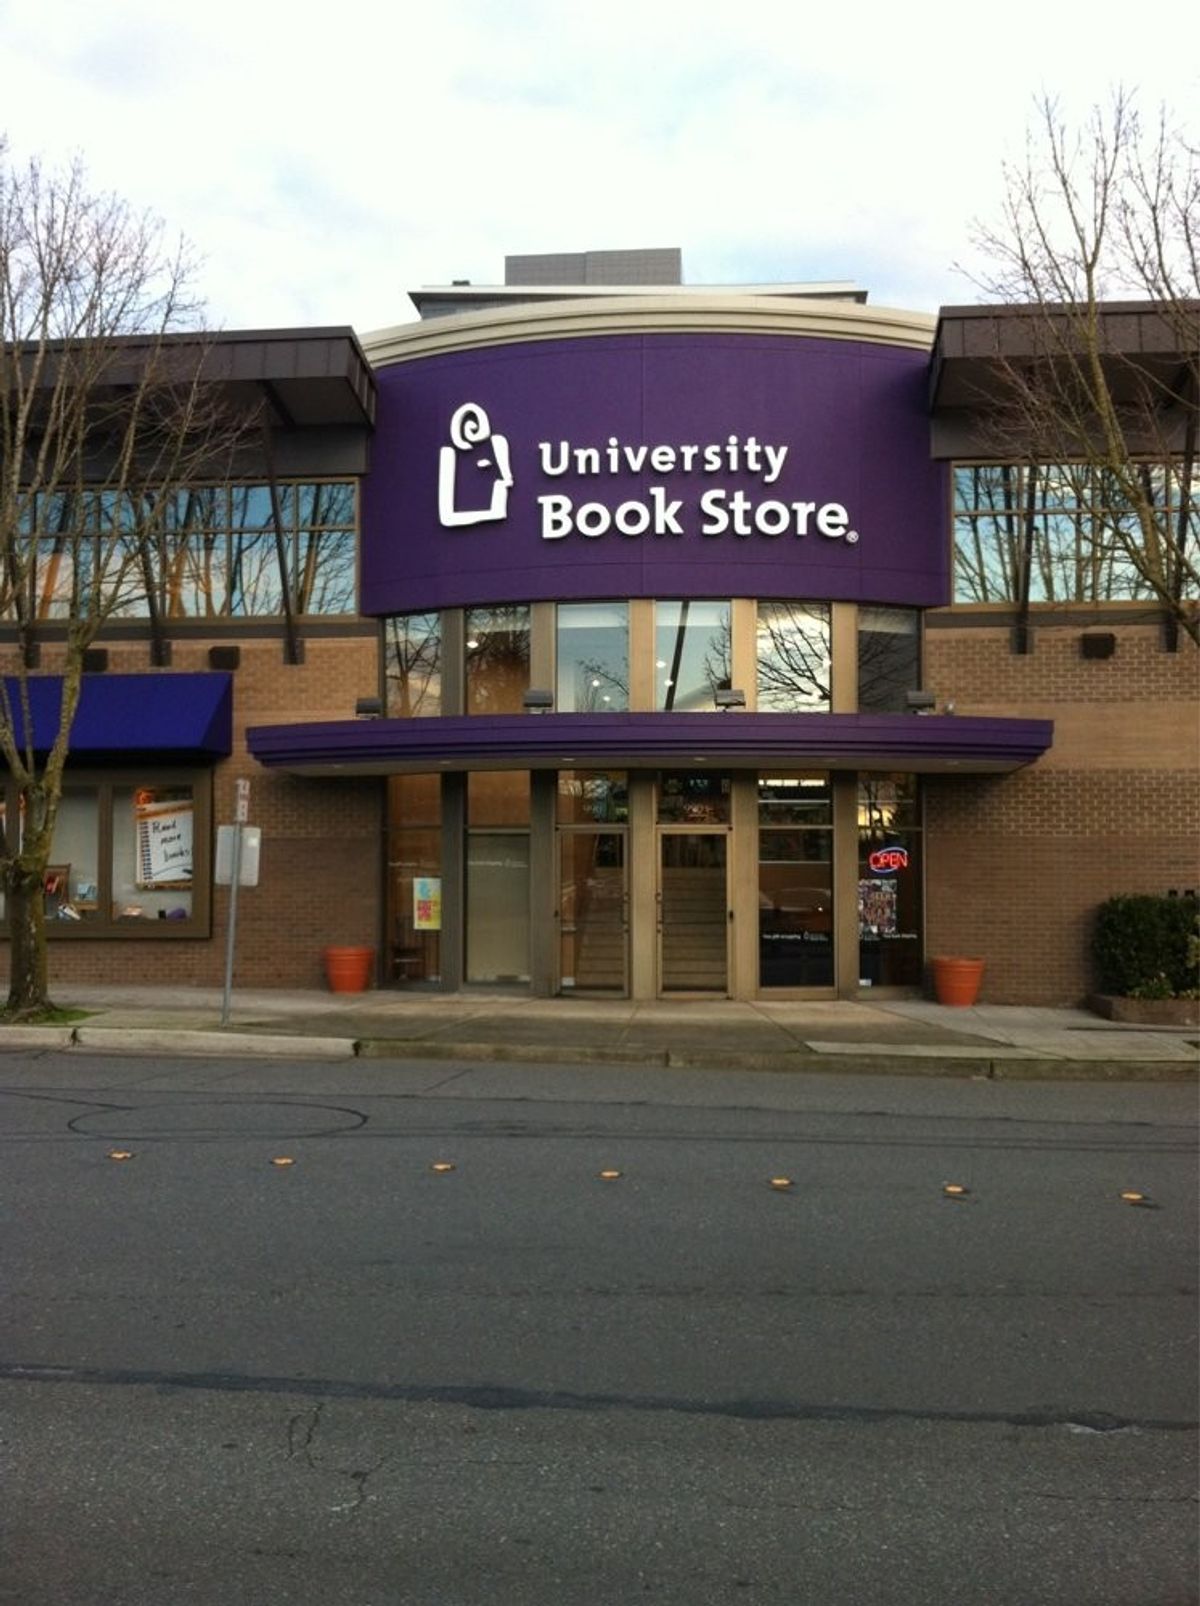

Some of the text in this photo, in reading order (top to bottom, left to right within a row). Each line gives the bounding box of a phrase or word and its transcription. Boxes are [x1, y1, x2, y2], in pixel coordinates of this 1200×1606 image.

[539, 435, 788, 483] University
[537, 487, 684, 539] Book
[869, 852, 908, 869] OPEN
